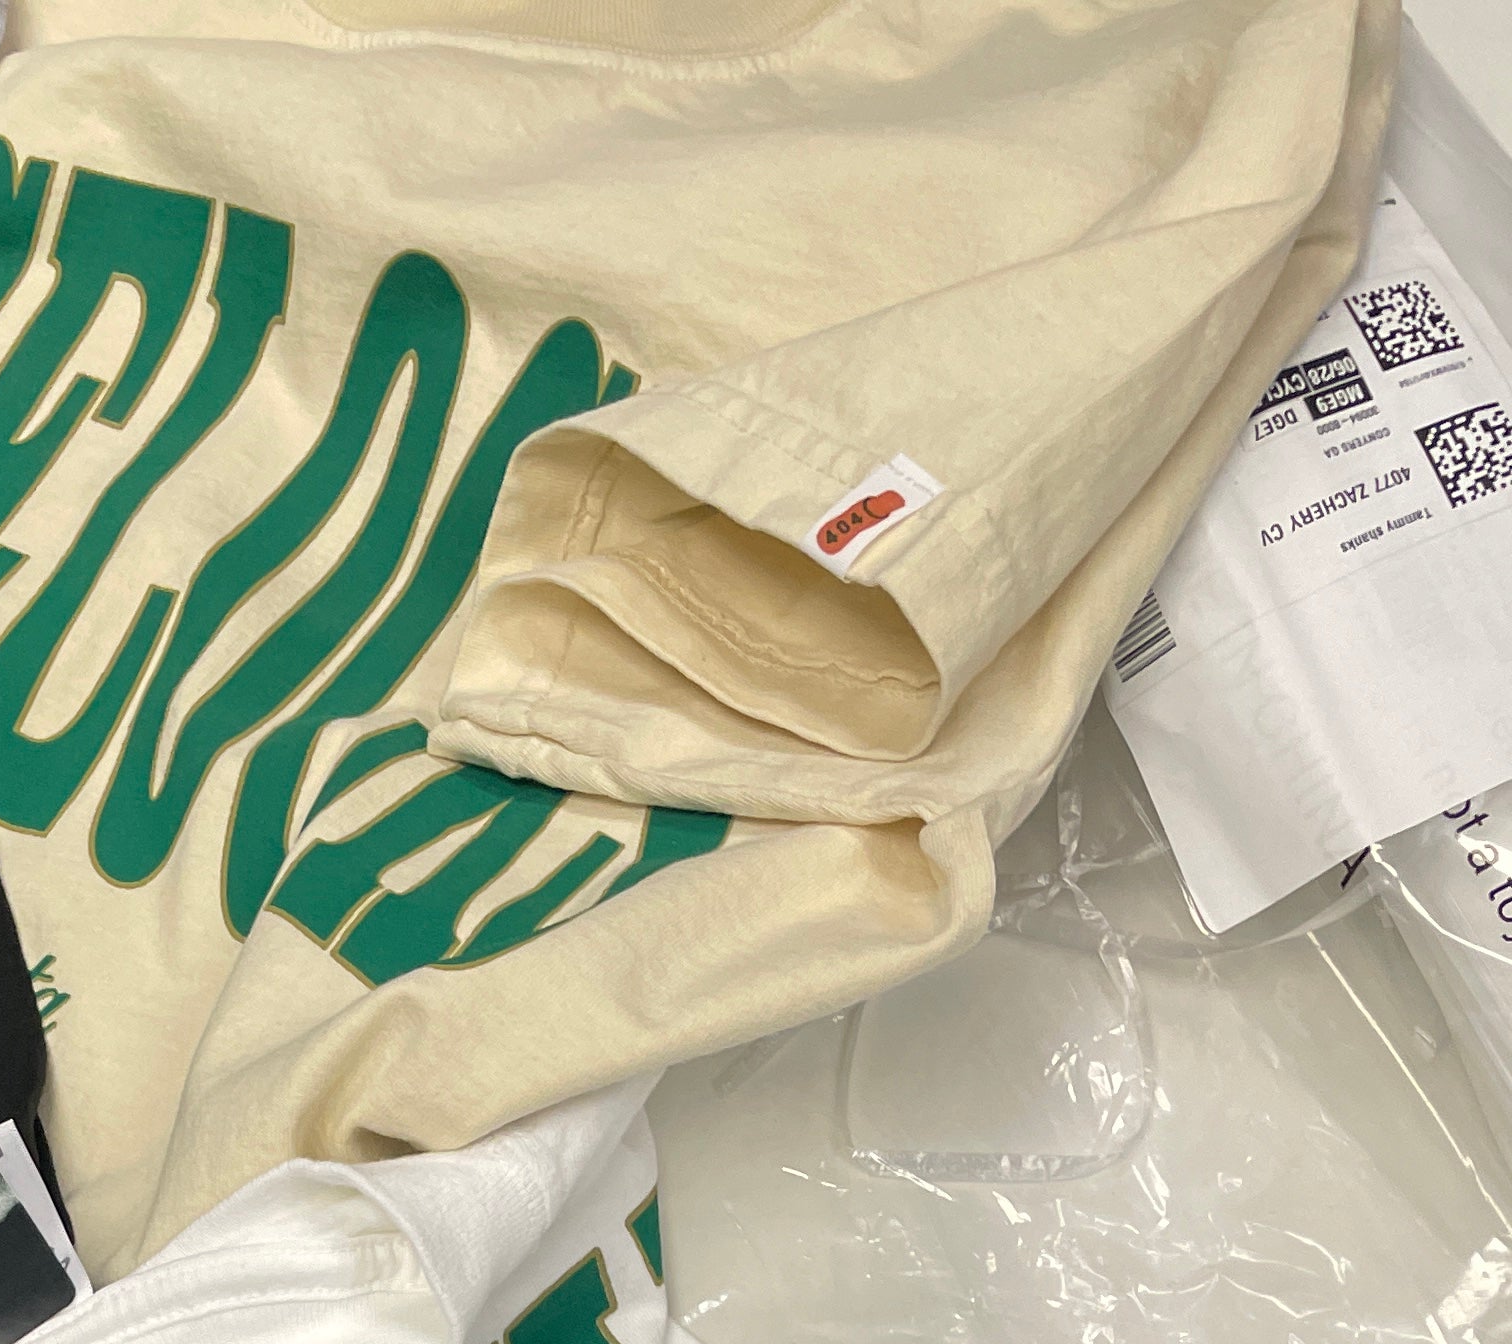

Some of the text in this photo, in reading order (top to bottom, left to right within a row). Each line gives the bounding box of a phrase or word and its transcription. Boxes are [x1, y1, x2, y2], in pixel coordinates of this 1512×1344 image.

[1254, 383, 1364, 441] MGE9 DGE7
[825, 511, 863, 545] 404
[1261, 467, 1411, 547] 4077 ZACHERY CV
[1340, 507, 1433, 553] Tammy shanks
